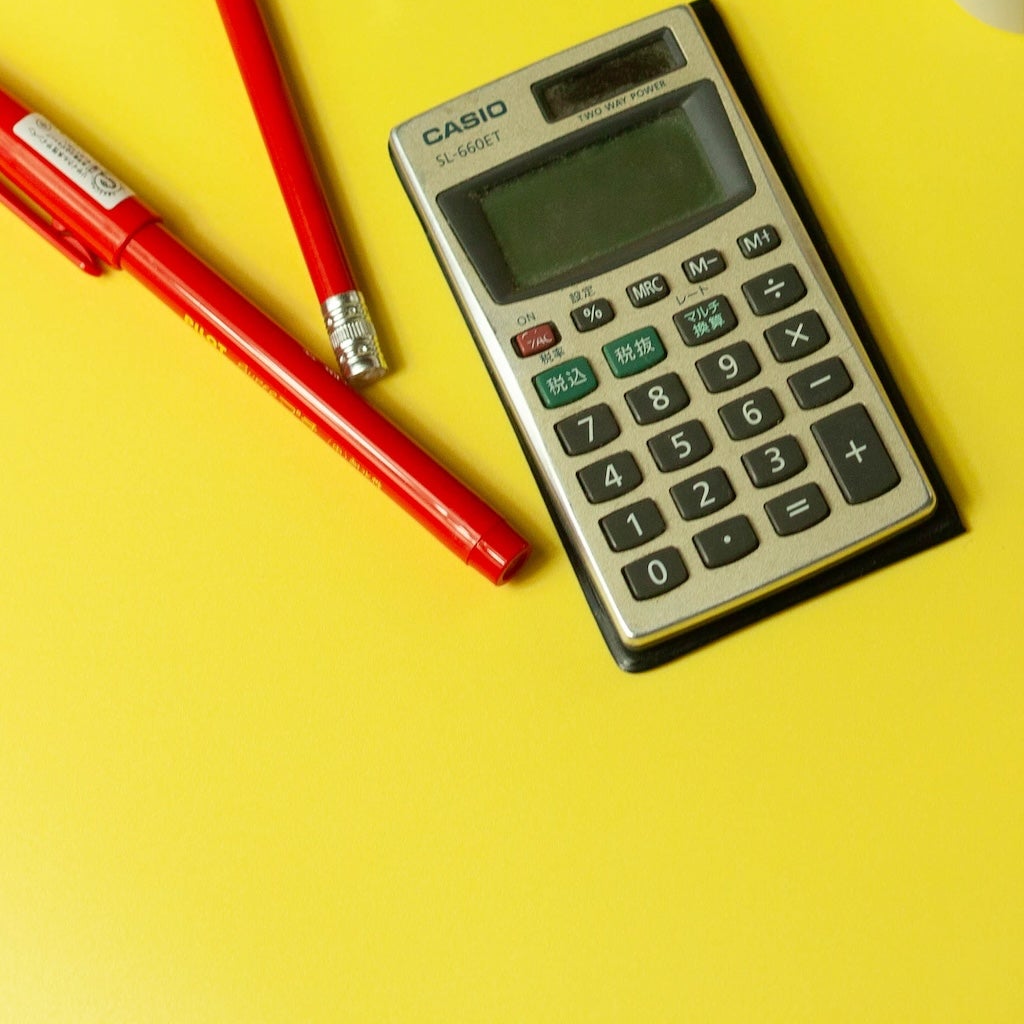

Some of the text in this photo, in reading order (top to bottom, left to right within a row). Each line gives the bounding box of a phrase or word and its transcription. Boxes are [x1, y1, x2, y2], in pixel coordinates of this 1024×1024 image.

[577, 80, 668, 124] TWO WAY POWER
[422, 99, 508, 147] CASIO
[435, 130, 502, 168] SL-660ET
[743, 228, 772, 252] M+
[632, 276, 665, 302] MRC
[676, 285, 709, 306] レート
[517, 312, 536, 326] ON
[583, 304, 603, 323] %
[684, 299, 720, 322] マルチ
[692, 313, 726, 338] 換算
[615, 336, 656, 365] 税抜
[718, 354, 740, 380] 9
[547, 367, 587, 396] 税込
[647, 386, 670, 412] 8
[742, 400, 763, 426] 6
[577, 416, 596, 444] 7
[670, 432, 692, 459] 5
[764, 446, 786, 473] 3
[603, 463, 623, 489] 4
[692, 480, 716, 508] 2
[626, 512, 644, 538] 1
[647, 559, 669, 586] 0
